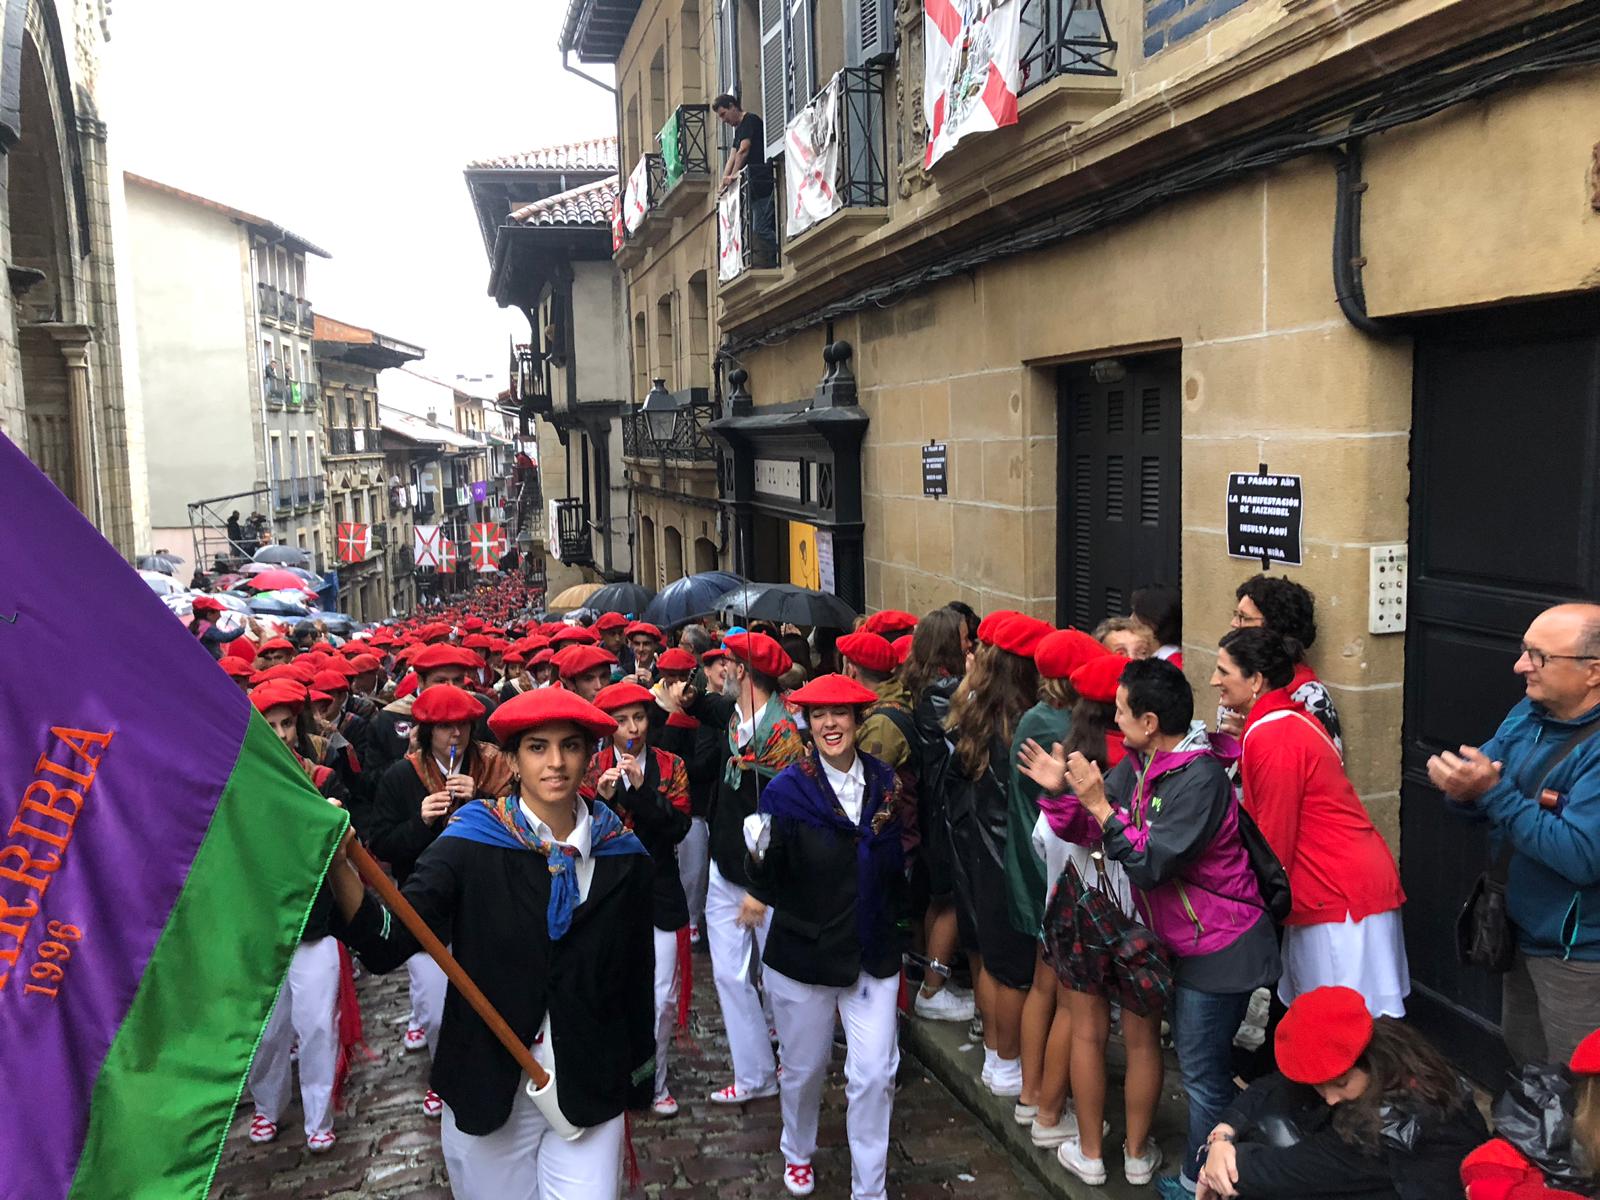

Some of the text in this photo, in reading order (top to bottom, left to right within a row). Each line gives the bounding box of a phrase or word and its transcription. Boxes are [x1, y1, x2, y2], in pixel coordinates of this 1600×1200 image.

[1237, 476, 1245, 485] EL
[1247, 477, 1278, 486] PASADO
[1229, 495, 1238, 503] LA
[1249, 546, 1264, 555] UNA
[24, 919, 83, 1000] 1996
